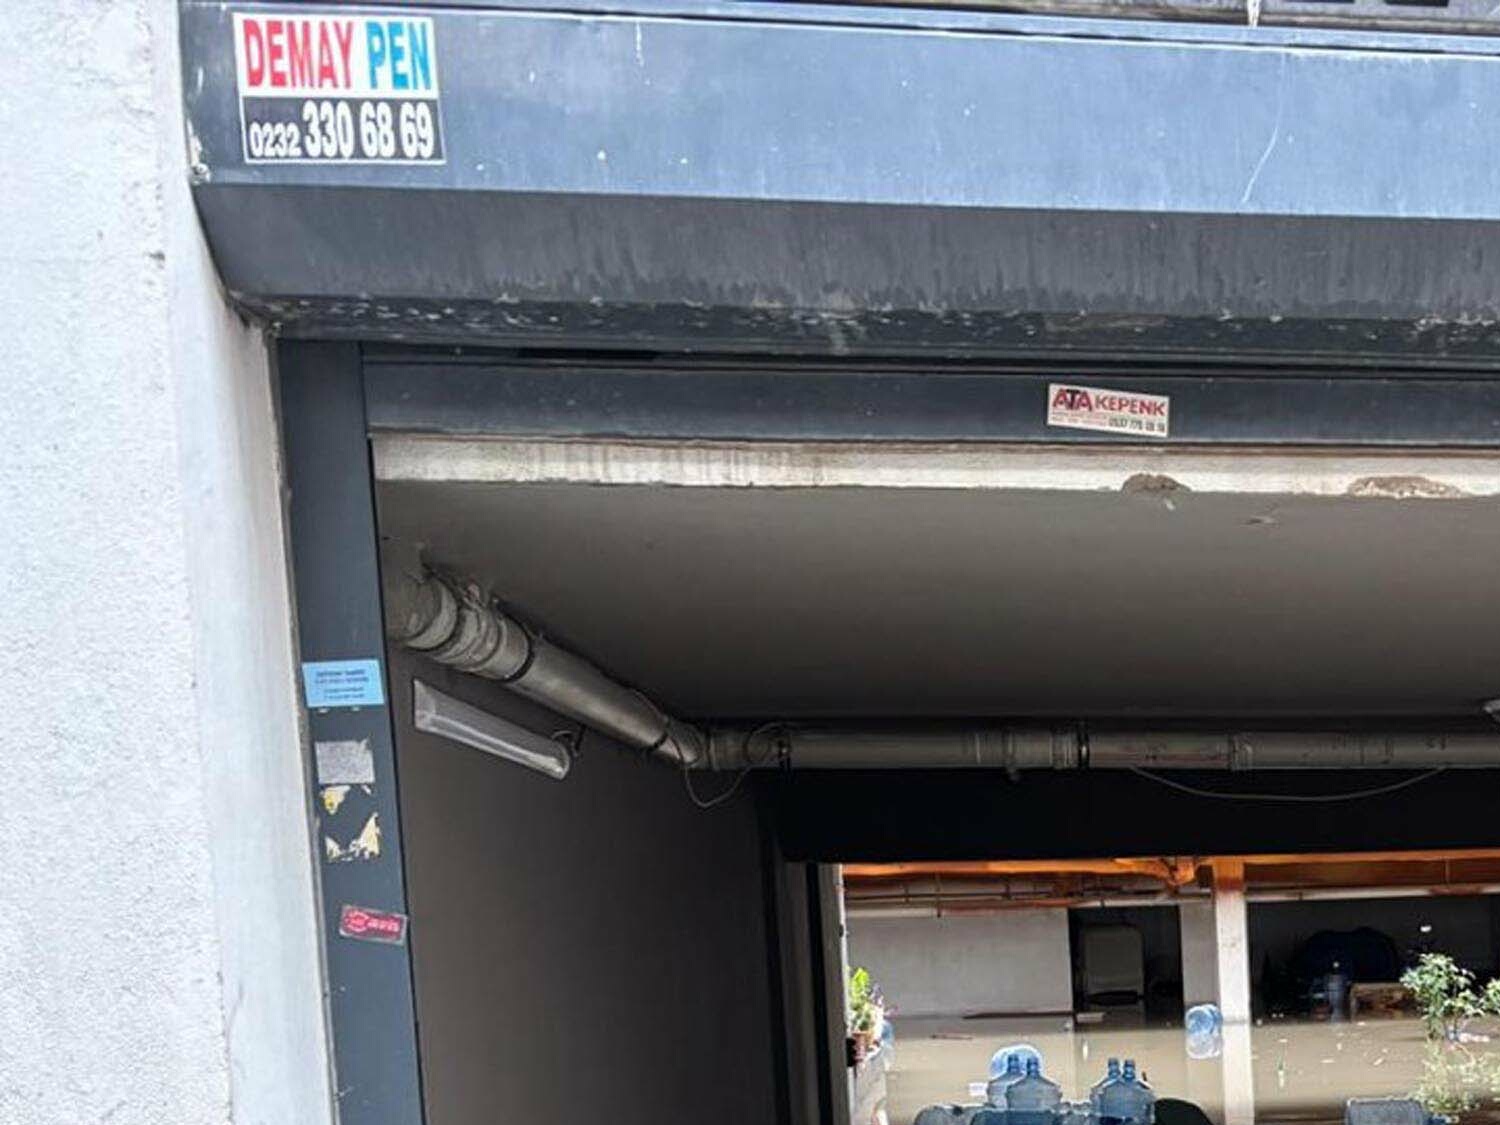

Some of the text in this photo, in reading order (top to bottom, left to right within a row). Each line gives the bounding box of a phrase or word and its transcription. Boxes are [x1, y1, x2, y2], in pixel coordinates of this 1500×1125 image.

[243, 19, 432, 90] DEMAY PEN
[250, 99, 435, 158] 0232 330 68 69
[1052, 388, 1166, 417] ATA KEPENK
